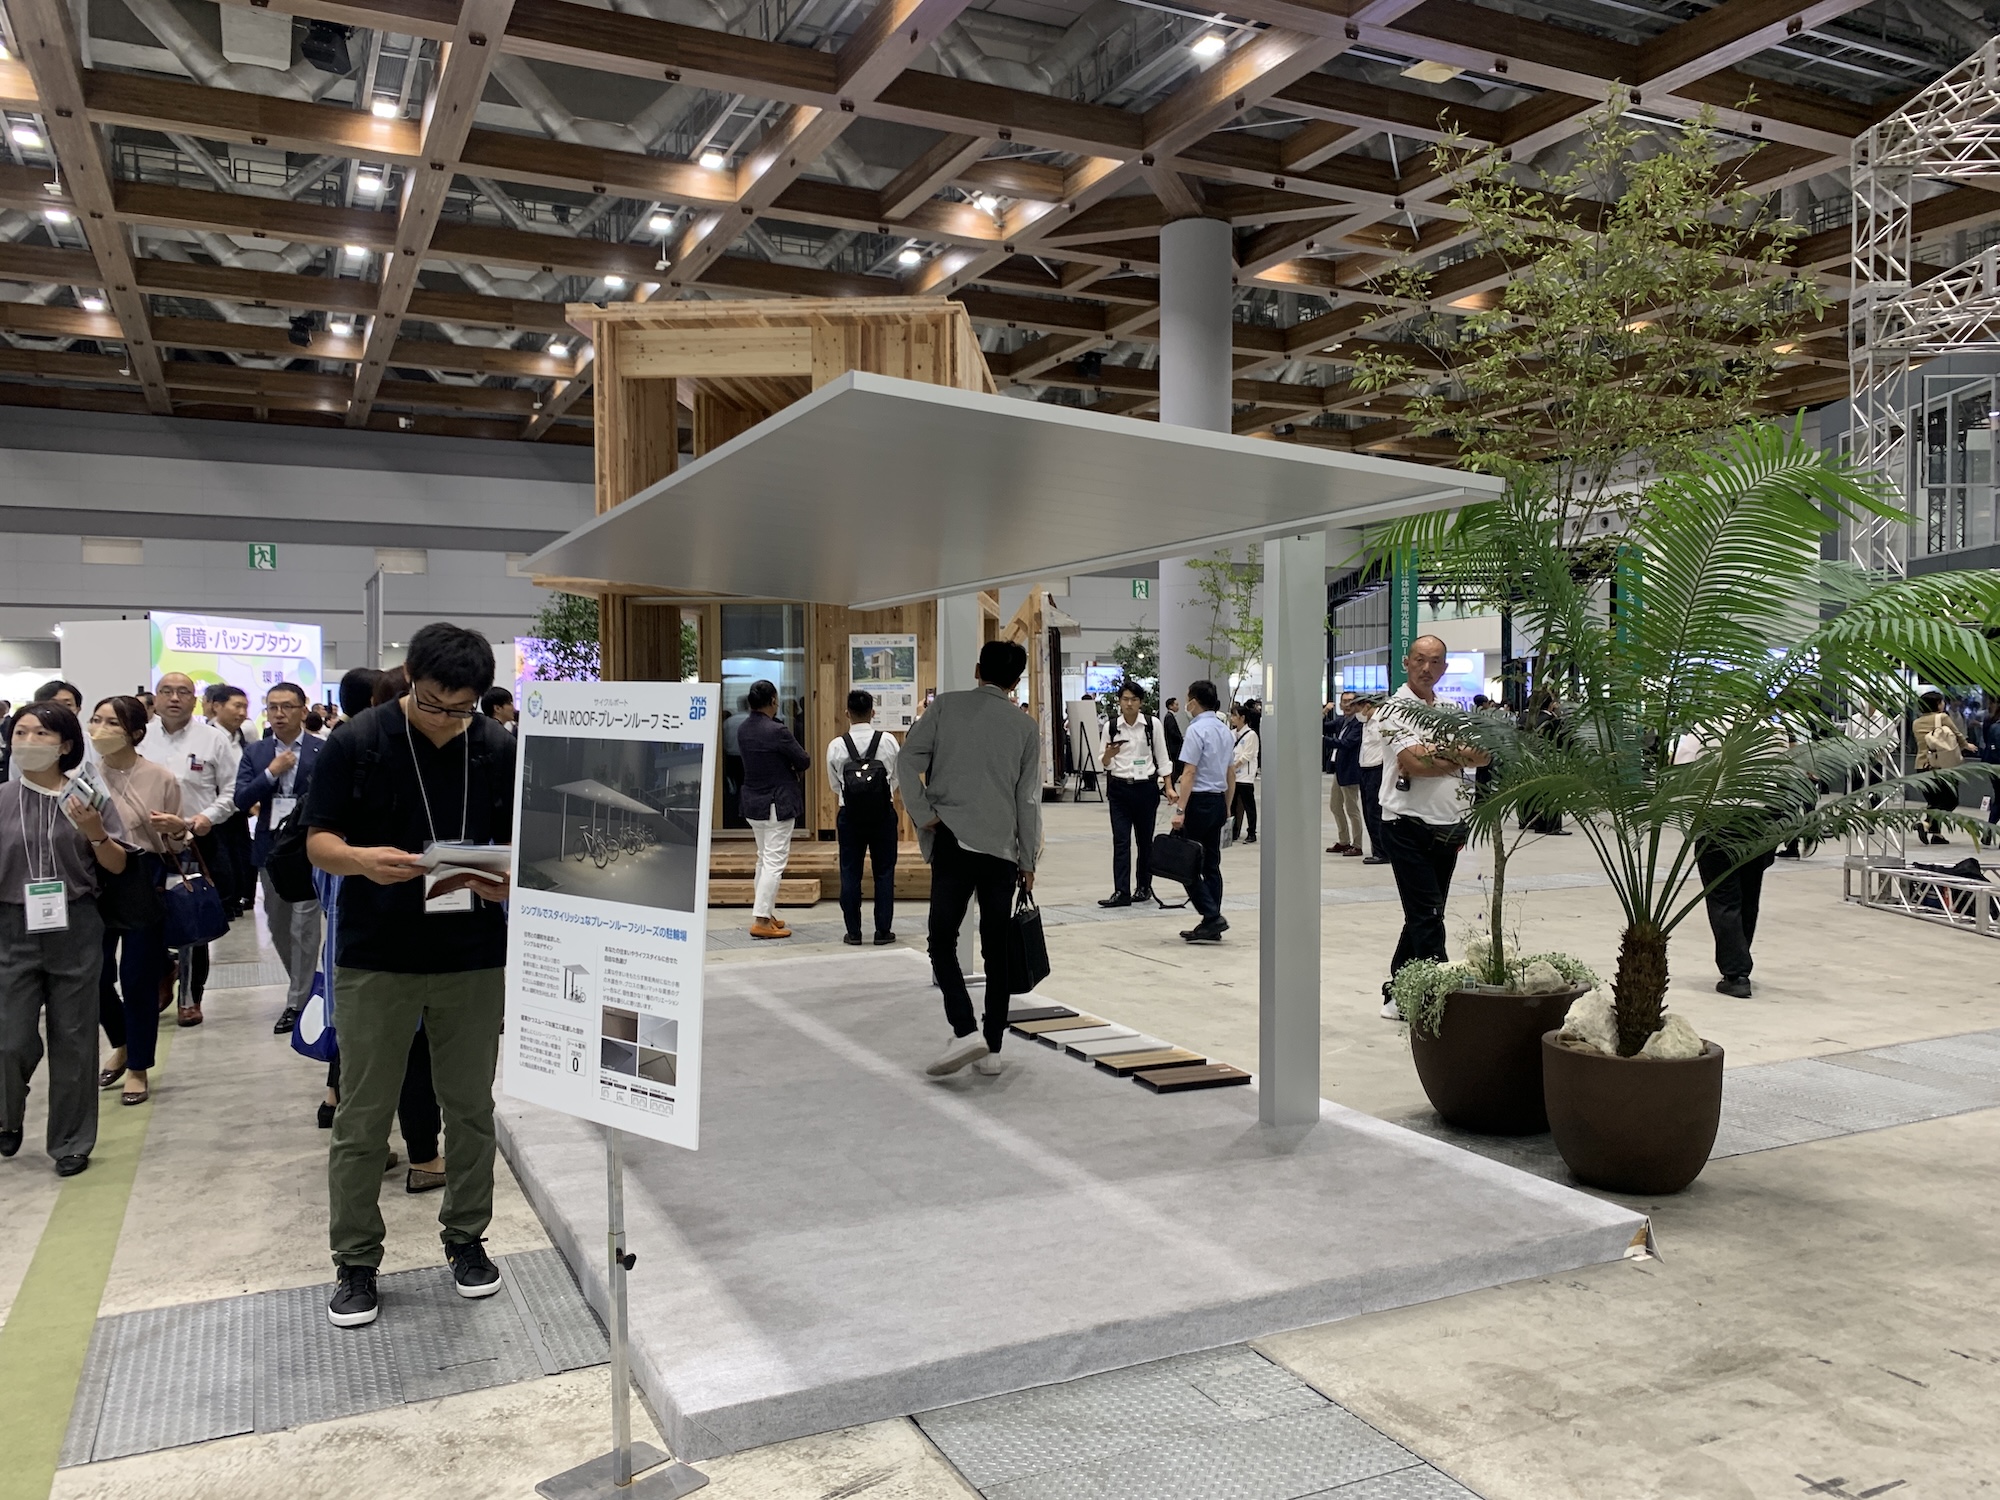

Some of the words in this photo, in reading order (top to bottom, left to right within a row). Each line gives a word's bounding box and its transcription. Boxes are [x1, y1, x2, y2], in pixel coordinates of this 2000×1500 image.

[176, 627, 302, 653] 環境・パッシブタウン
[690, 696, 707, 706] YKK
[542, 710, 568, 725] PLAIN
[520, 905, 688, 942] シンプルでスタイリッシュなプレーンルーフシリーズの駐輪場
[572, 1057, 579, 1072] 0
